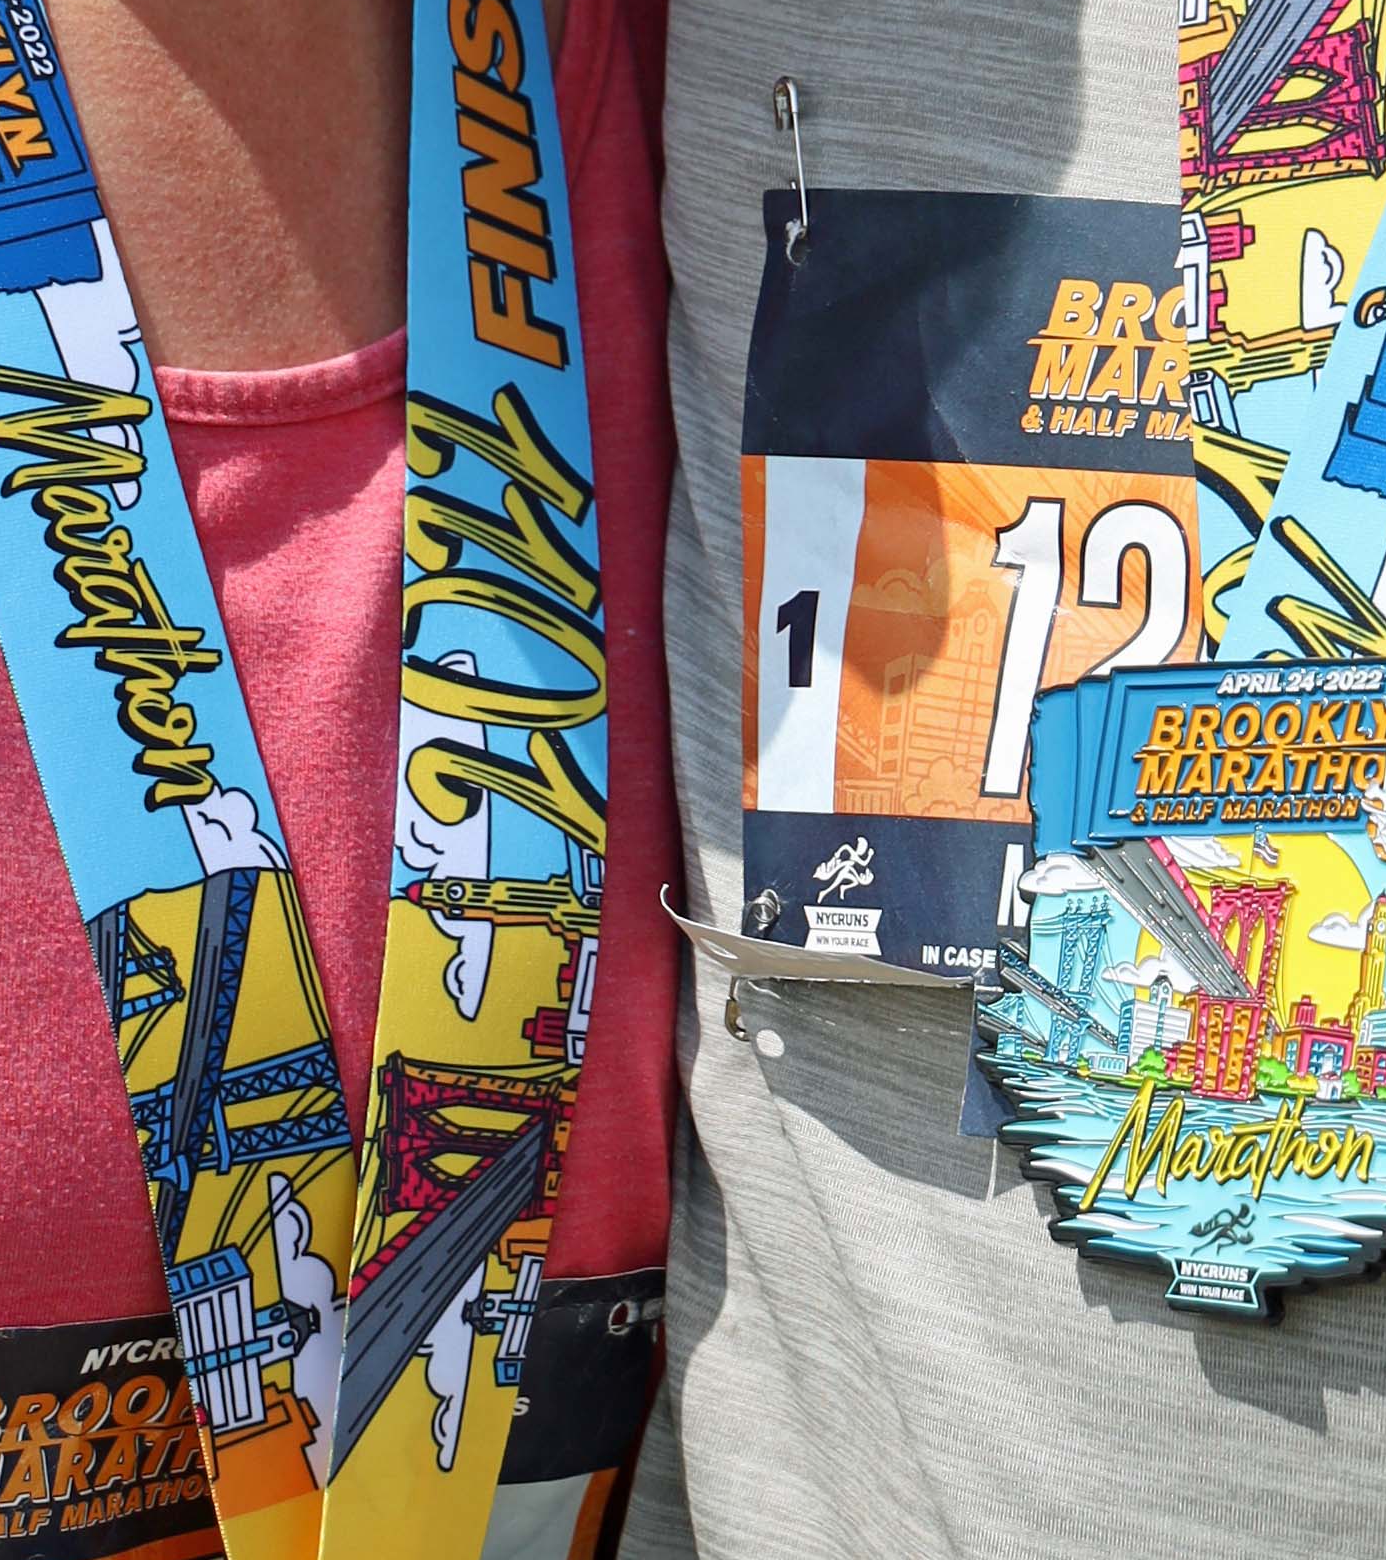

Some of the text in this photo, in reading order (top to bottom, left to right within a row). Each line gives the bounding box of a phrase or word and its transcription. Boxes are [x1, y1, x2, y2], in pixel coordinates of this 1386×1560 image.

[1020, 404, 1044, 434] &
[1048, 405, 1139, 438] HALF
[401, 381, 607, 857] 2022
[776, 590, 820, 688] 1
[1216, 671, 1283, 696] APRIL
[1129, 797, 1363, 823] & HALF MARATHON
[815, 911, 870, 928] NYCRUNS
[815, 935, 870, 948] WIN YOUR RACE
[921, 945, 997, 968] IN CASE
[1078, 1078, 1375, 1212] Marathon
[1179, 1260, 1250, 1282] NYCRUNS
[1179, 1282, 1246, 1302] WIN YOUR RACE
